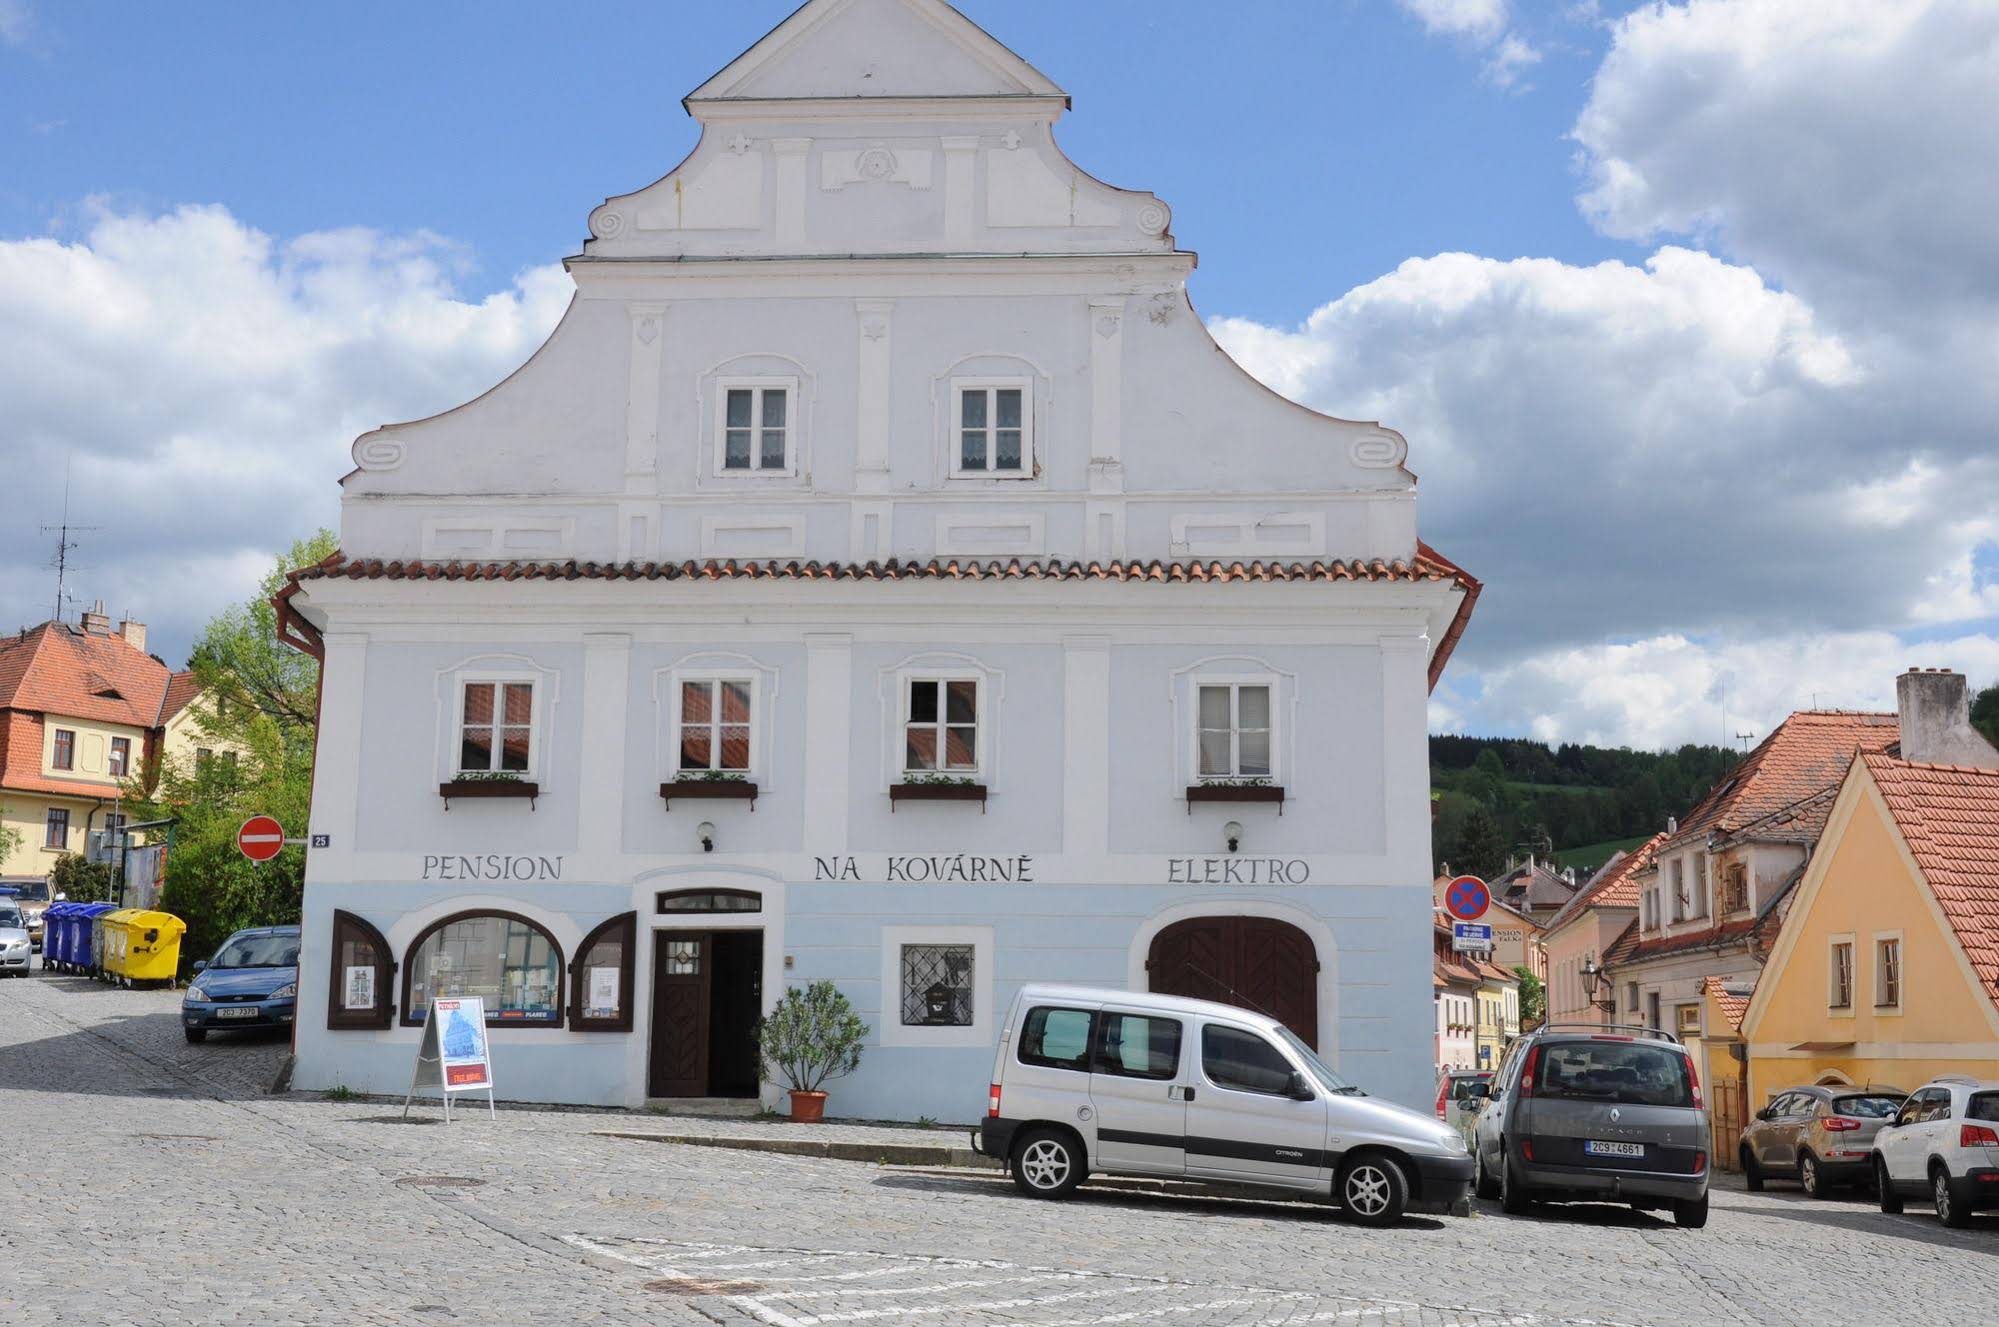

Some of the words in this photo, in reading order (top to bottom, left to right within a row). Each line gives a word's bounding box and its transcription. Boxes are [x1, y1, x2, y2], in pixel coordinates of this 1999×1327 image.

[315, 836, 326, 846] 25
[422, 855, 563, 880] PENSION
[814, 856, 861, 880] NA
[887, 853, 1034, 881] KOVÁRNĚ
[1168, 858, 1310, 884] ELEKTRO
[1492, 929, 1521, 937] ENSION
[1592, 1142, 1610, 1153] 2C9
[1617, 1144, 1640, 1154] 4661
